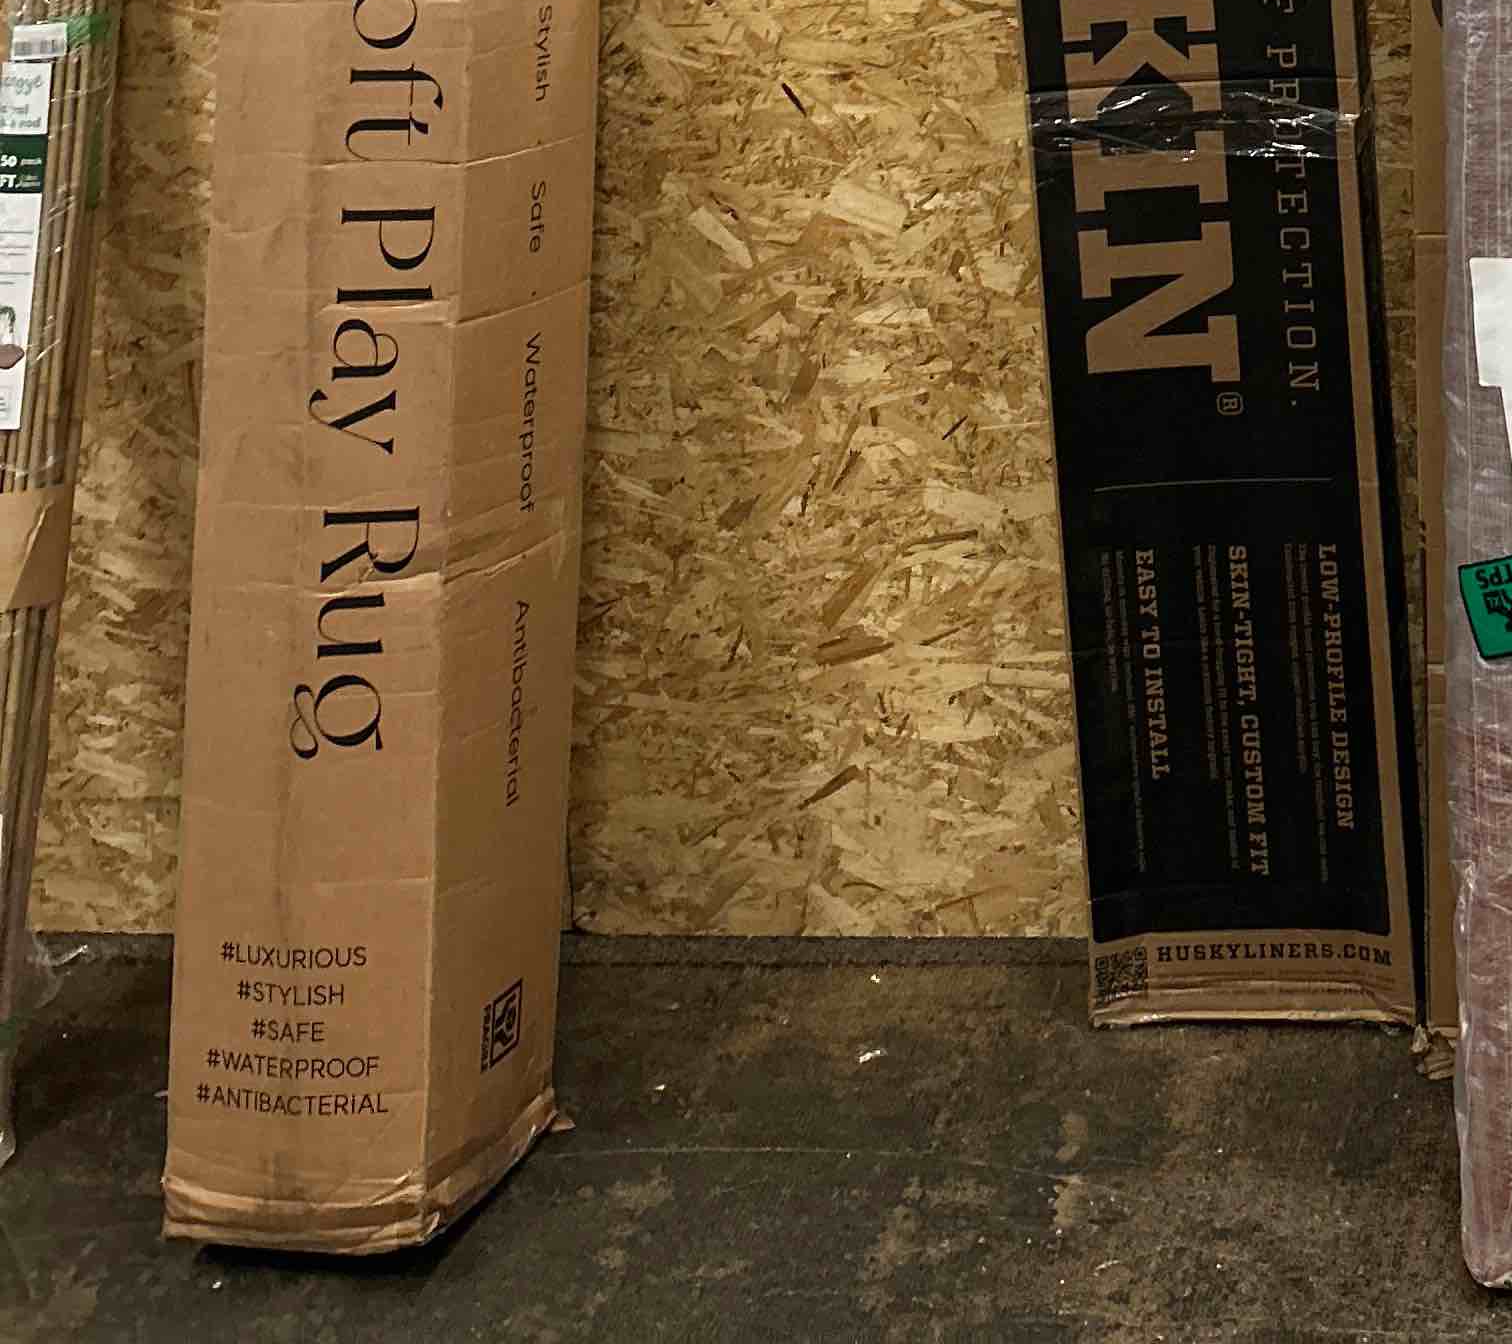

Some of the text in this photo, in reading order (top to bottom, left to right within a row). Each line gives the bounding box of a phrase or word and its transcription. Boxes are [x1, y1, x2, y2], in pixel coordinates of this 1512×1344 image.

[534, 4, 554, 103] Stylish
[528, 181, 547, 254] Safe
[309, 206, 436, 455] Play
[519, 331, 542, 512] Waterproof
[290, 507, 421, 758] Rug
[1135, 549, 1175, 781] EASY TO INSTALL
[505, 599, 530, 807] Antibacterial
[1228, 544, 1271, 877] SKIN-TIGHT, CUSTOM FIT
[1318, 543, 1355, 831] LOW-PROFILE DESIGN
[220, 941, 367, 970] #LUXURIOUS
[237, 980, 345, 1007] #STYLISH
[1156, 943, 1392, 966] HUSKYLINERS.COM
[206, 1047, 380, 1079] #WATERPROOF
[251, 1018, 325, 1042] #SAFE
[195, 1083, 389, 1117] #ANTIBACTERIAL
